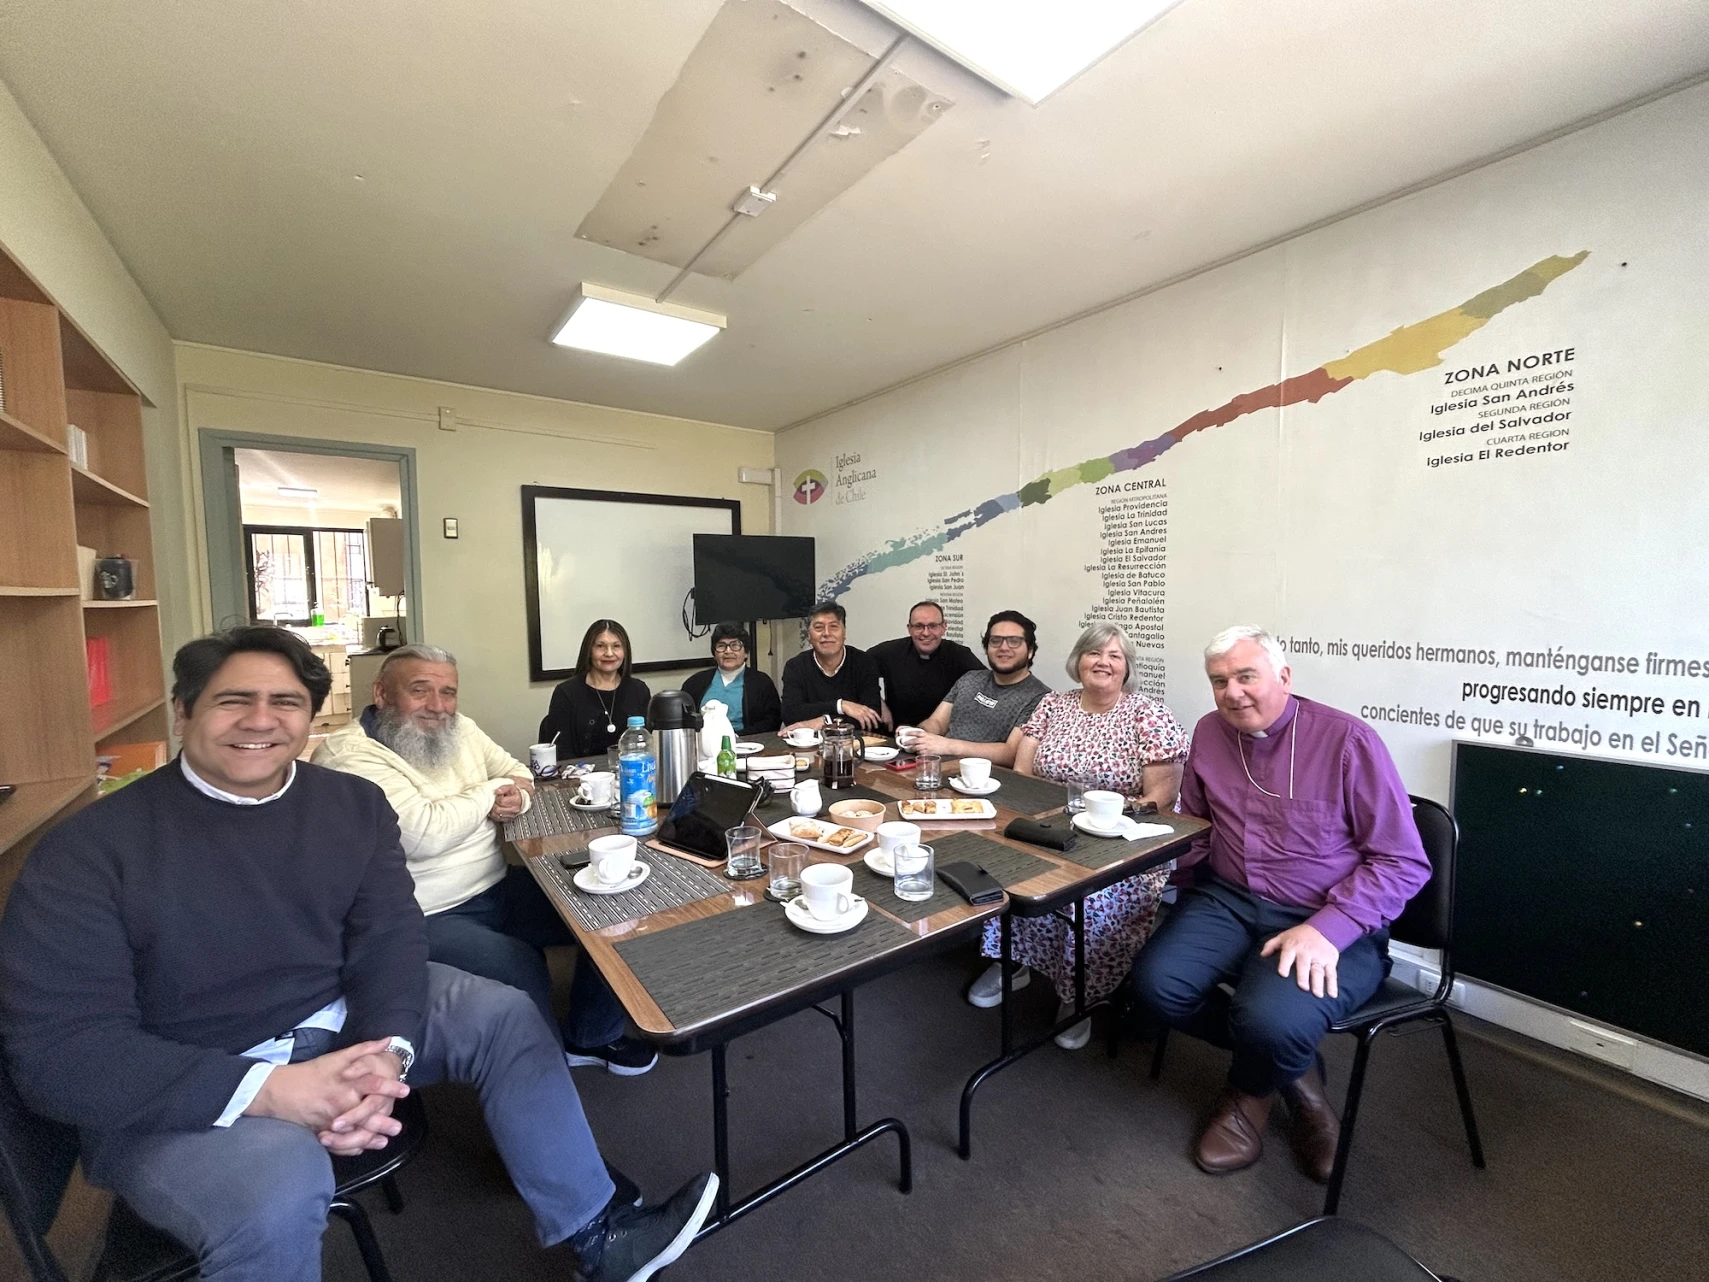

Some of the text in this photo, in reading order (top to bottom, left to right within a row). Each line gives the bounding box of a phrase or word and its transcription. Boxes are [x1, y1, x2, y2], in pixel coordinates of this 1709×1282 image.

[1444, 347, 1576, 385] ZONA NORTE
[1451, 369, 1573, 398] DECIMA QUINTA REGIÓN
[1431, 379, 1575, 416] Iglesia San Andrés
[1478, 405, 1527, 419] SEGUNDA
[1419, 410, 1572, 442] Iglesia del Salvador
[1486, 434, 1526, 446] CUARTA
[836, 451, 861, 472] Iglesia
[1427, 441, 1570, 468] Iglesia El Redentor
[836, 469, 877, 488] Anglicana
[1096, 479, 1166, 495] ZONA CENTRAL
[835, 489, 866, 505] de Chile
[1099, 500, 1167, 514] Iglesia Providencia
[1102, 513, 1125, 522] Iglesia
[1138, 509, 1167, 518] Trinidad
[1104, 522, 1127, 531] Iglesia
[1100, 531, 1122, 539] Iglesia
[1109, 536, 1166, 547] Iglesia Emanuel
[1101, 548, 1123, 556] Iglesia
[1101, 556, 1122, 564] Iglesia
[1084, 564, 1106, 572] Iglesia
[1102, 572, 1124, 580] Iglesia
[1108, 589, 1130, 597] Iglesia
[1103, 597, 1125, 605] Iglesia
[1127, 632, 1164, 640] antagallo
[1290, 636, 1323, 657] tanto,
[1327, 638, 1348, 656] mis
[1352, 640, 1412, 661] queridos
[1416, 642, 1500, 668] hermanos,
[1506, 646, 1640, 676] manténganse
[1462, 682, 1701, 718] progresando siempre en
[1361, 704, 1709, 759] concientes de que su trabajo en el Señ
